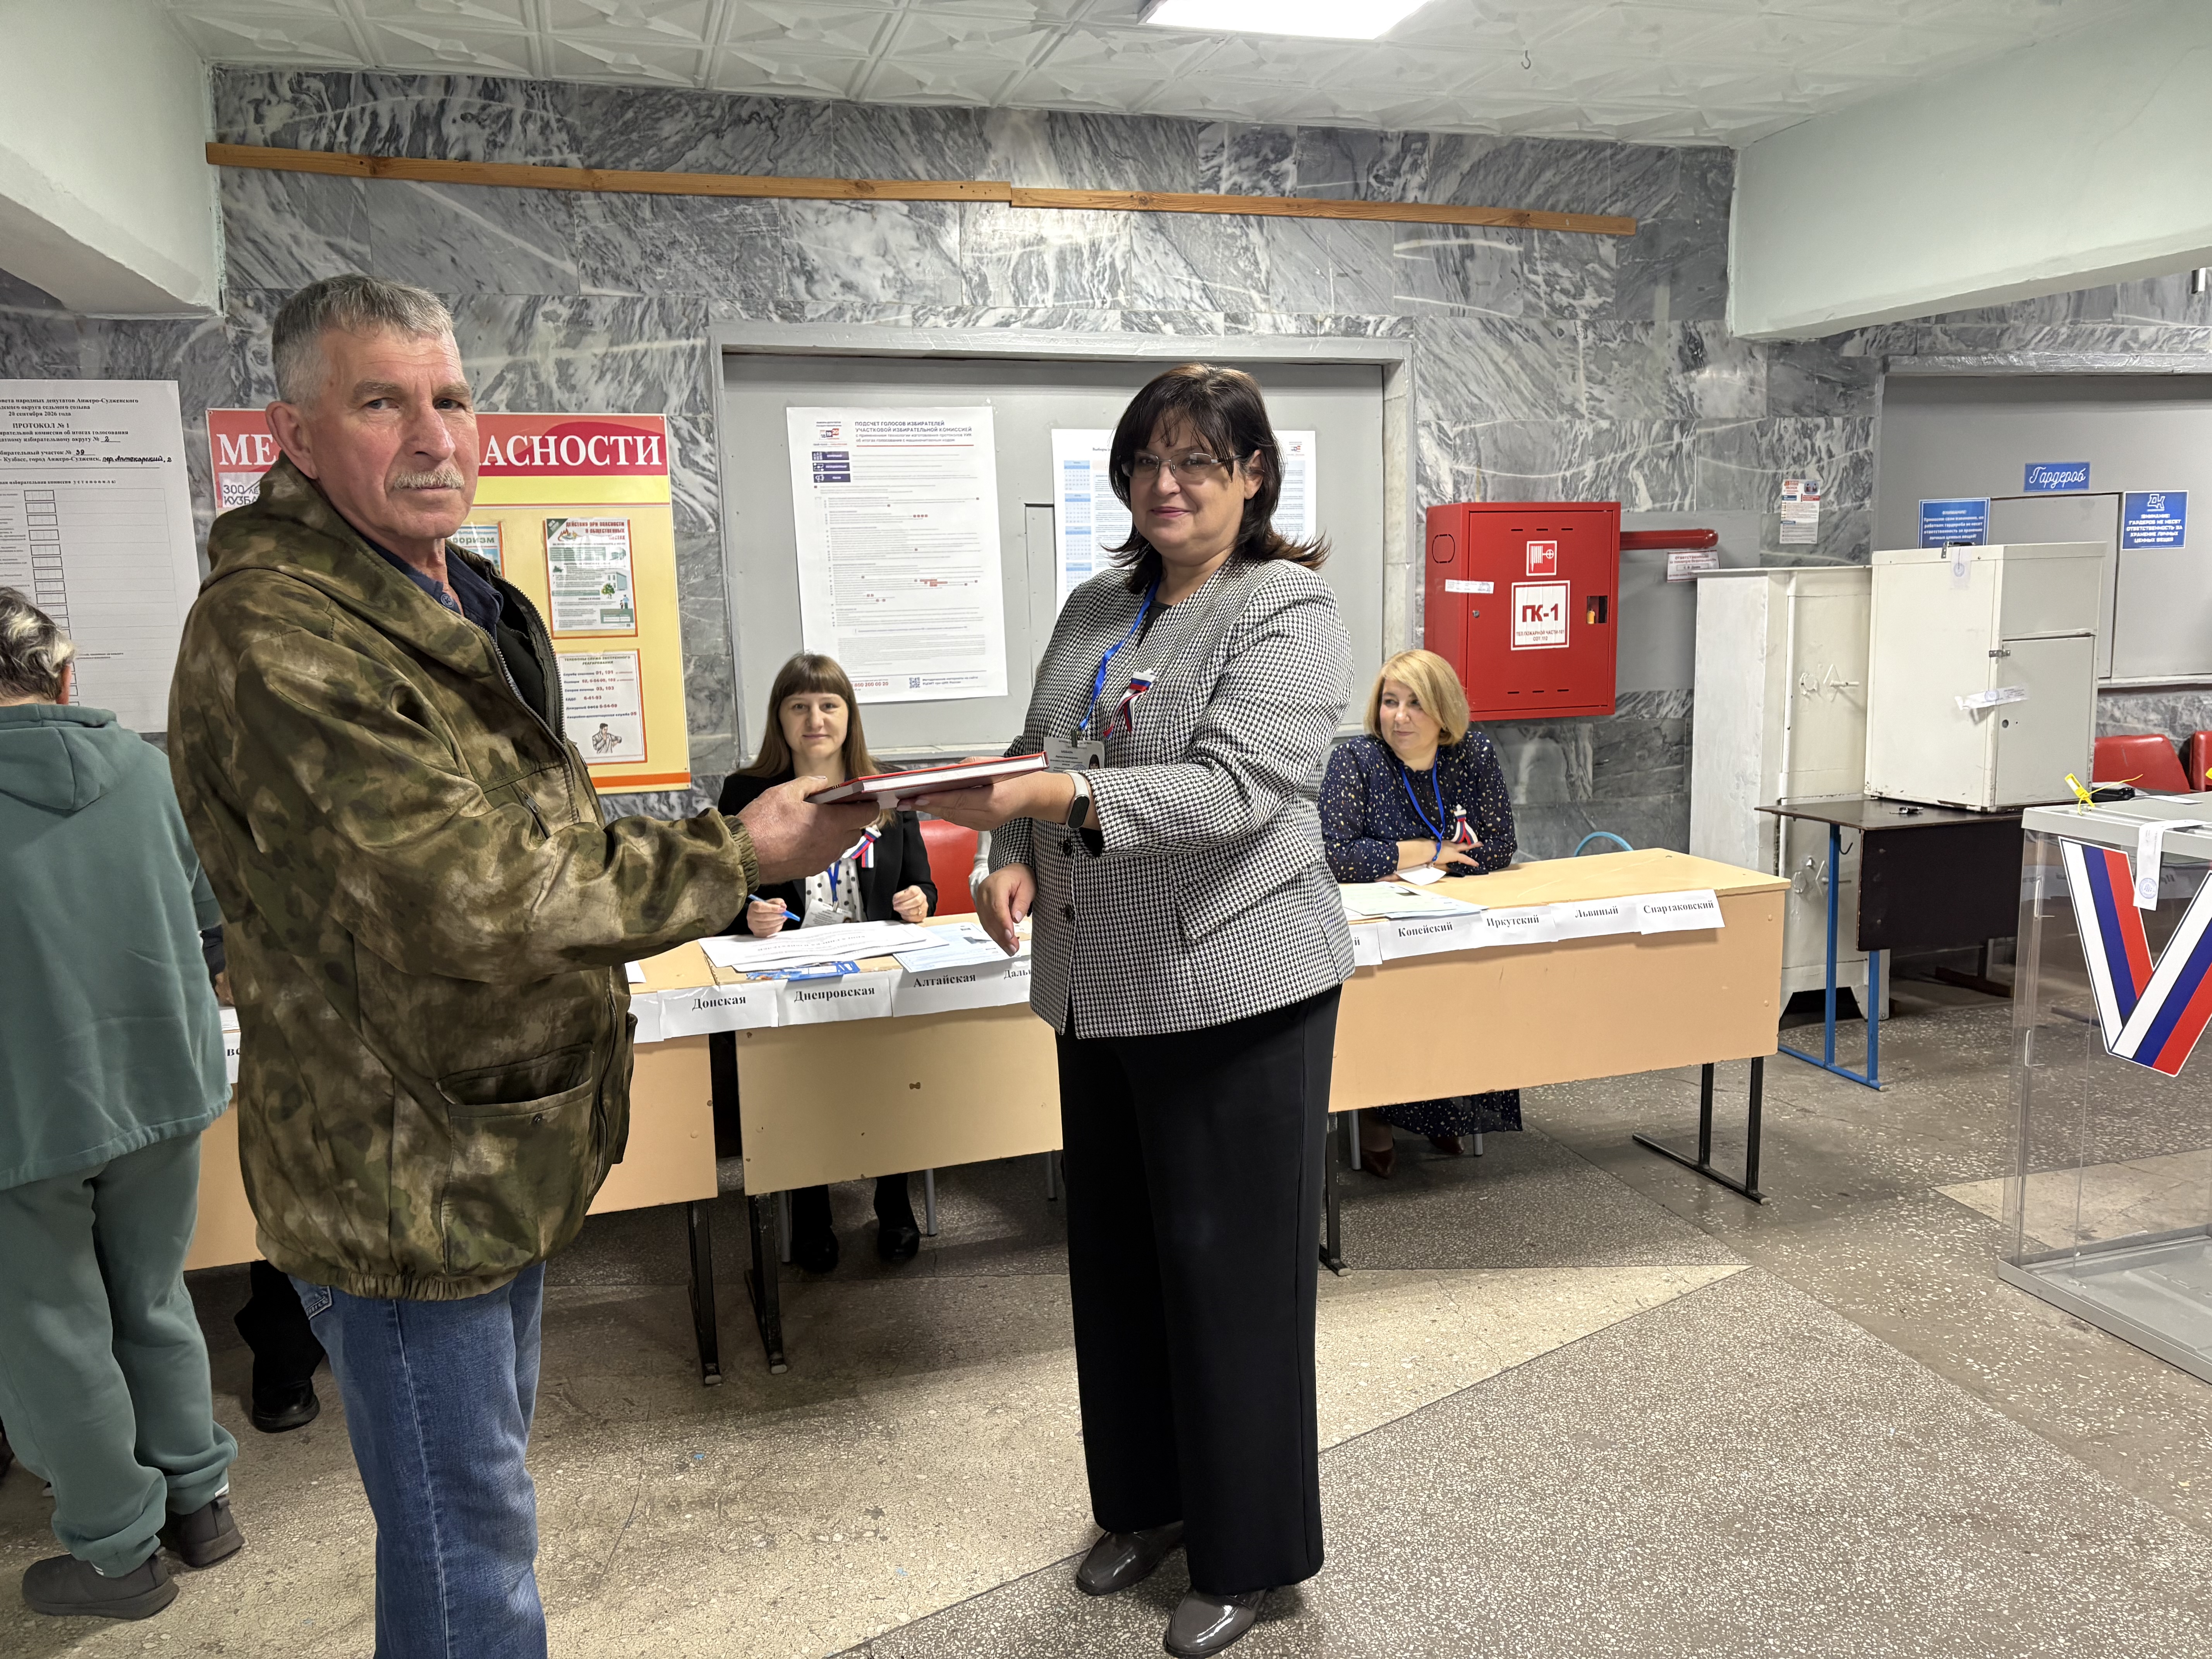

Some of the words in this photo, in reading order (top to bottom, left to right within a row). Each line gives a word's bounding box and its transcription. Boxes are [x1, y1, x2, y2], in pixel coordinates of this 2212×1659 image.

[216, 434, 276, 465] МЕ
[479, 435, 662, 465] АСНОСТИ
[2029, 466, 2086, 489] Гардероб
[223, 485, 244, 494] 300
[224, 496, 258, 505] КУЗБА
[1522, 603, 1558, 622] ПК-1
[1575, 905, 1619, 918] Львиный
[1643, 900, 1714, 914] Спартаковский
[1486, 914, 1540, 929] Иркутский
[1398, 922, 1453, 937] Копейский
[913, 974, 976, 988] Алтайская
[1003, 969, 1031, 980] Даль
[794, 987, 875, 1003] Днепровская
[692, 996, 746, 1012] Донская
